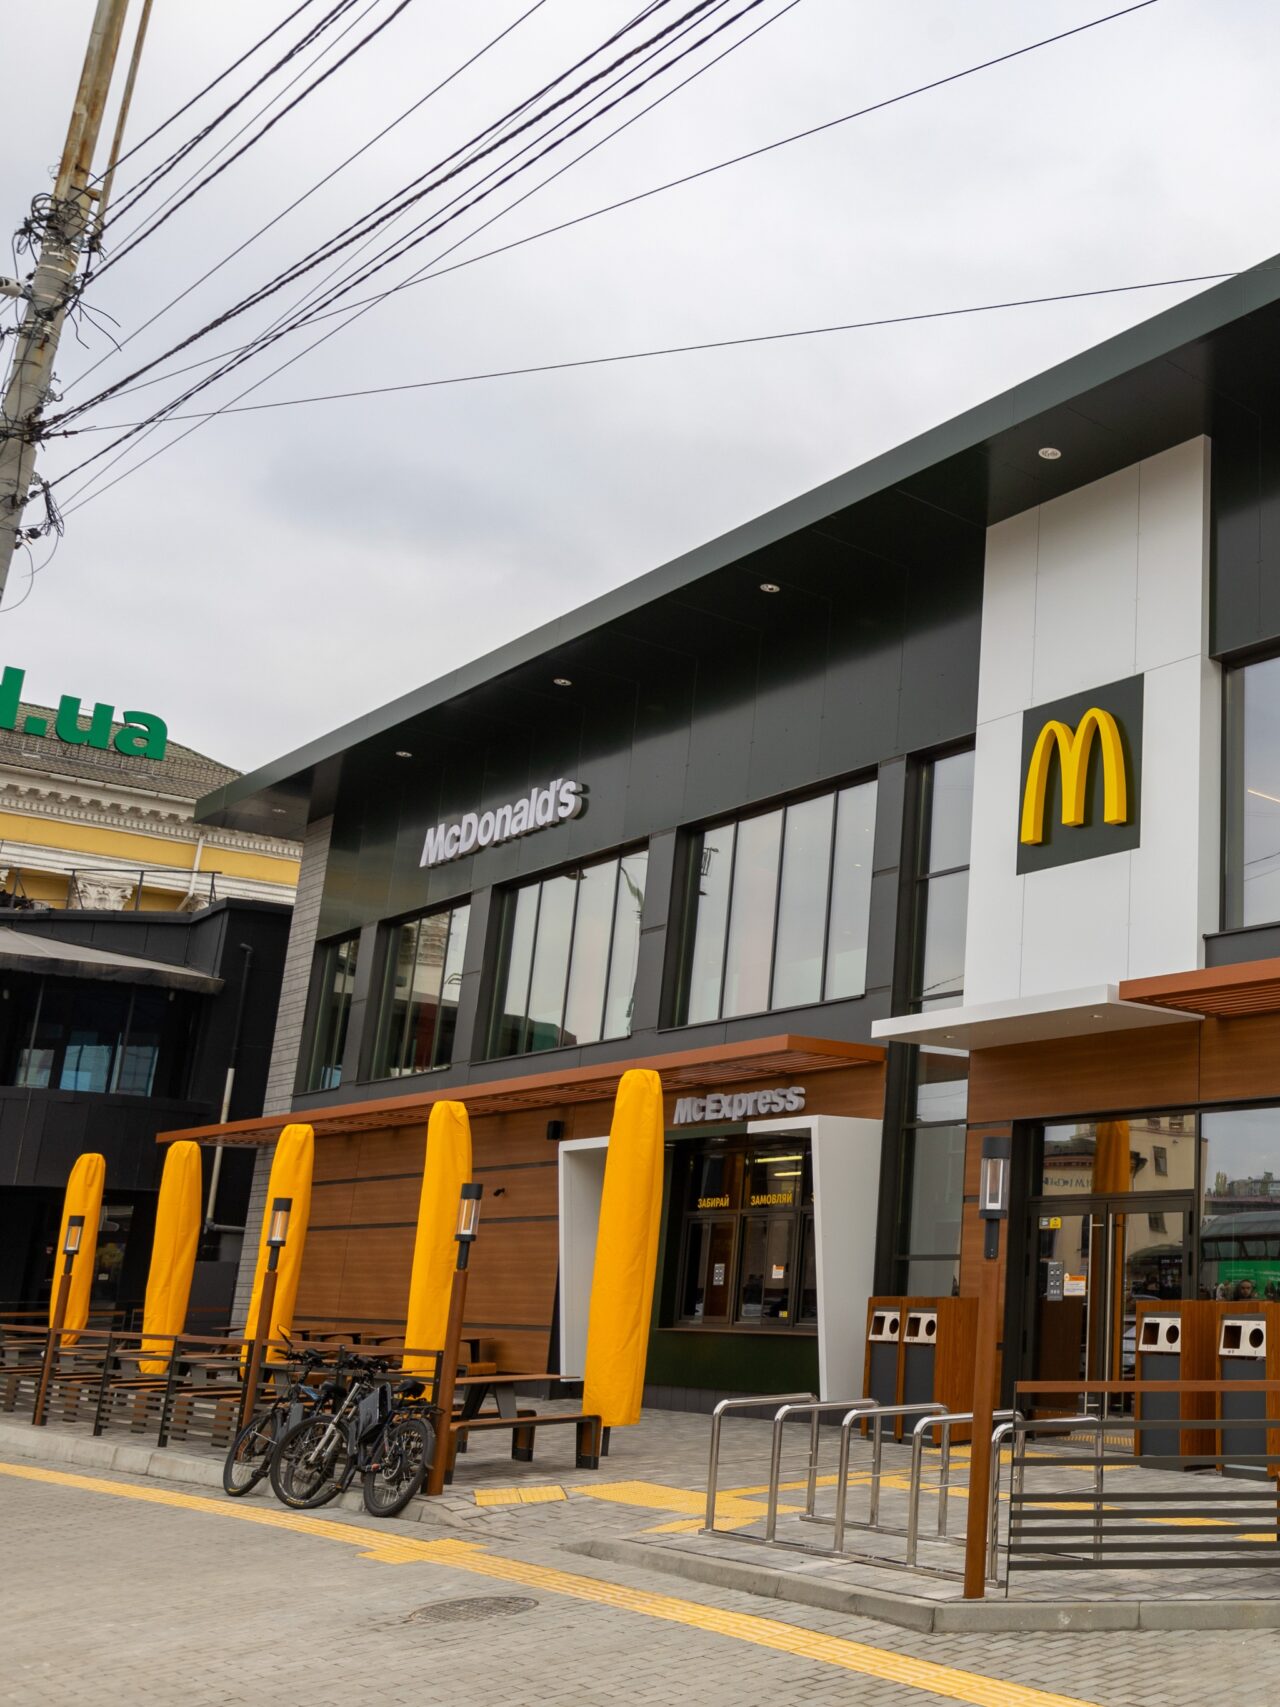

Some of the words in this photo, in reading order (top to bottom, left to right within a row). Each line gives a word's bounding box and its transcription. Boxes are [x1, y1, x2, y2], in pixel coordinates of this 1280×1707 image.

[1020, 707, 1127, 845] M
[419, 778, 583, 868] McDonald's
[673, 1086, 805, 1125] McExpress
[697, 1194, 730, 1209] ЗАБИРАЙ
[750, 1190, 793, 1206] ЗАМОВЛЯЙ
